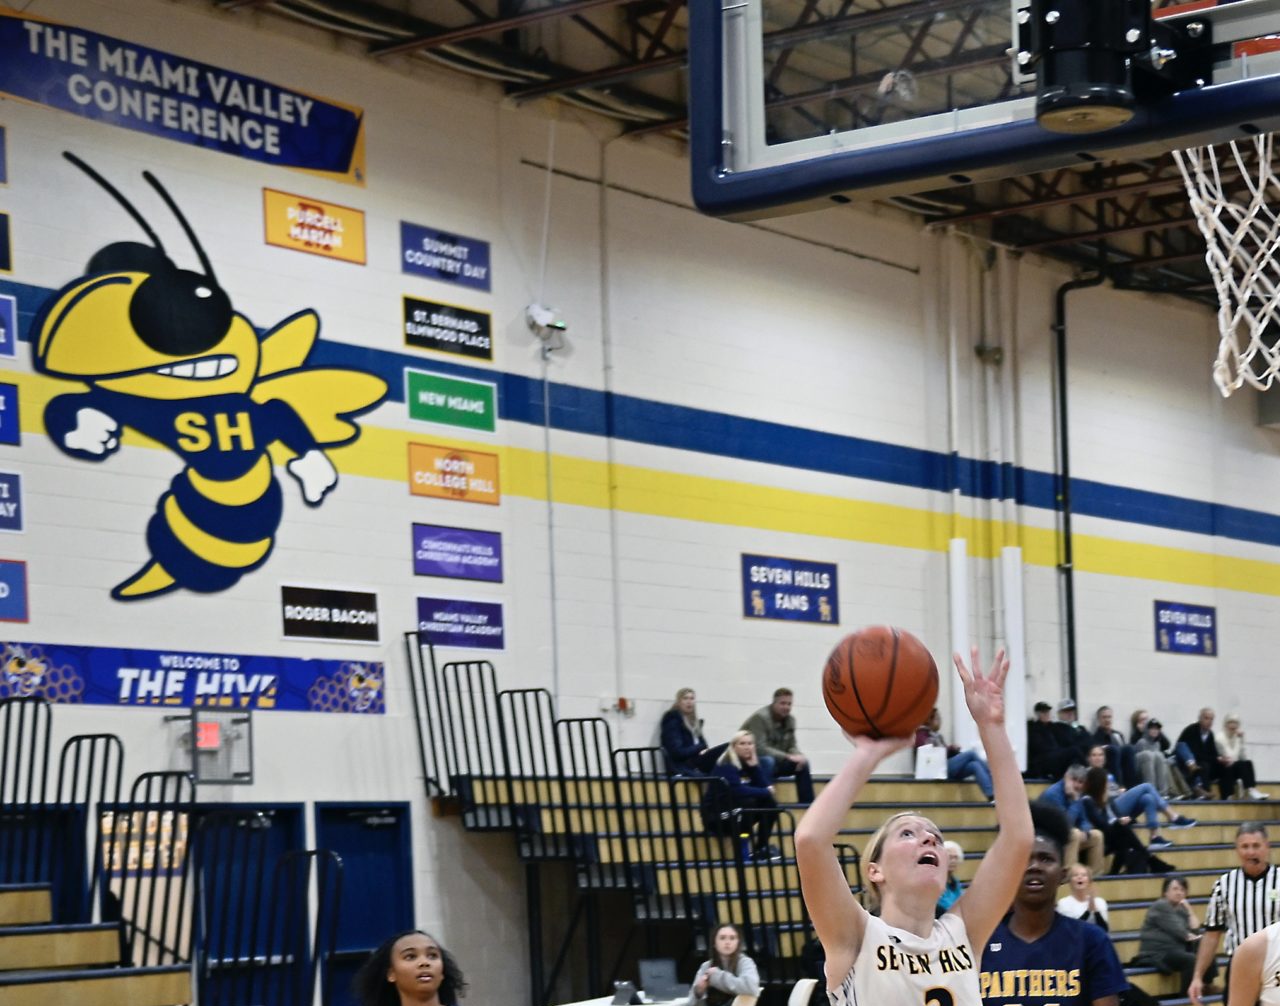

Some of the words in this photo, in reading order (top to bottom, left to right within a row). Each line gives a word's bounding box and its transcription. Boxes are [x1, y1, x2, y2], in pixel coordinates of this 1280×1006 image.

[23, 21, 88, 67] THE
[99, 41, 199, 98] MIAMI
[207, 72, 313, 127] VALLEY
[68, 74, 281, 156] CONFERENCE
[423, 237, 469, 260] SUMMIT
[405, 250, 462, 274] COUNTRY
[463, 262, 487, 280] DAY
[458, 332, 490, 350] PLACE
[418, 391, 446, 407] NEW
[447, 396, 484, 414] MIAMI
[174, 411, 255, 452] SH
[415, 471, 467, 490] COLLEGE
[468, 478, 495, 493] HILL
[750, 565, 792, 585] SEVEN
[793, 570, 830, 589] HILLS
[775, 592, 808, 611] FANS
[284, 605, 330, 621] ROGER
[331, 608, 377, 624] BACON
[1159, 610, 1187, 624] SEVEN
[1188, 613, 1211, 628] HILLS
[1175, 631, 1198, 646] FANS
[160, 654, 221, 670] WELCOME
[222, 658, 240, 671] TO
[117, 668, 187, 704] THE
[194, 672, 279, 708] HIVE
[979, 968, 1081, 999] PANTHERS
